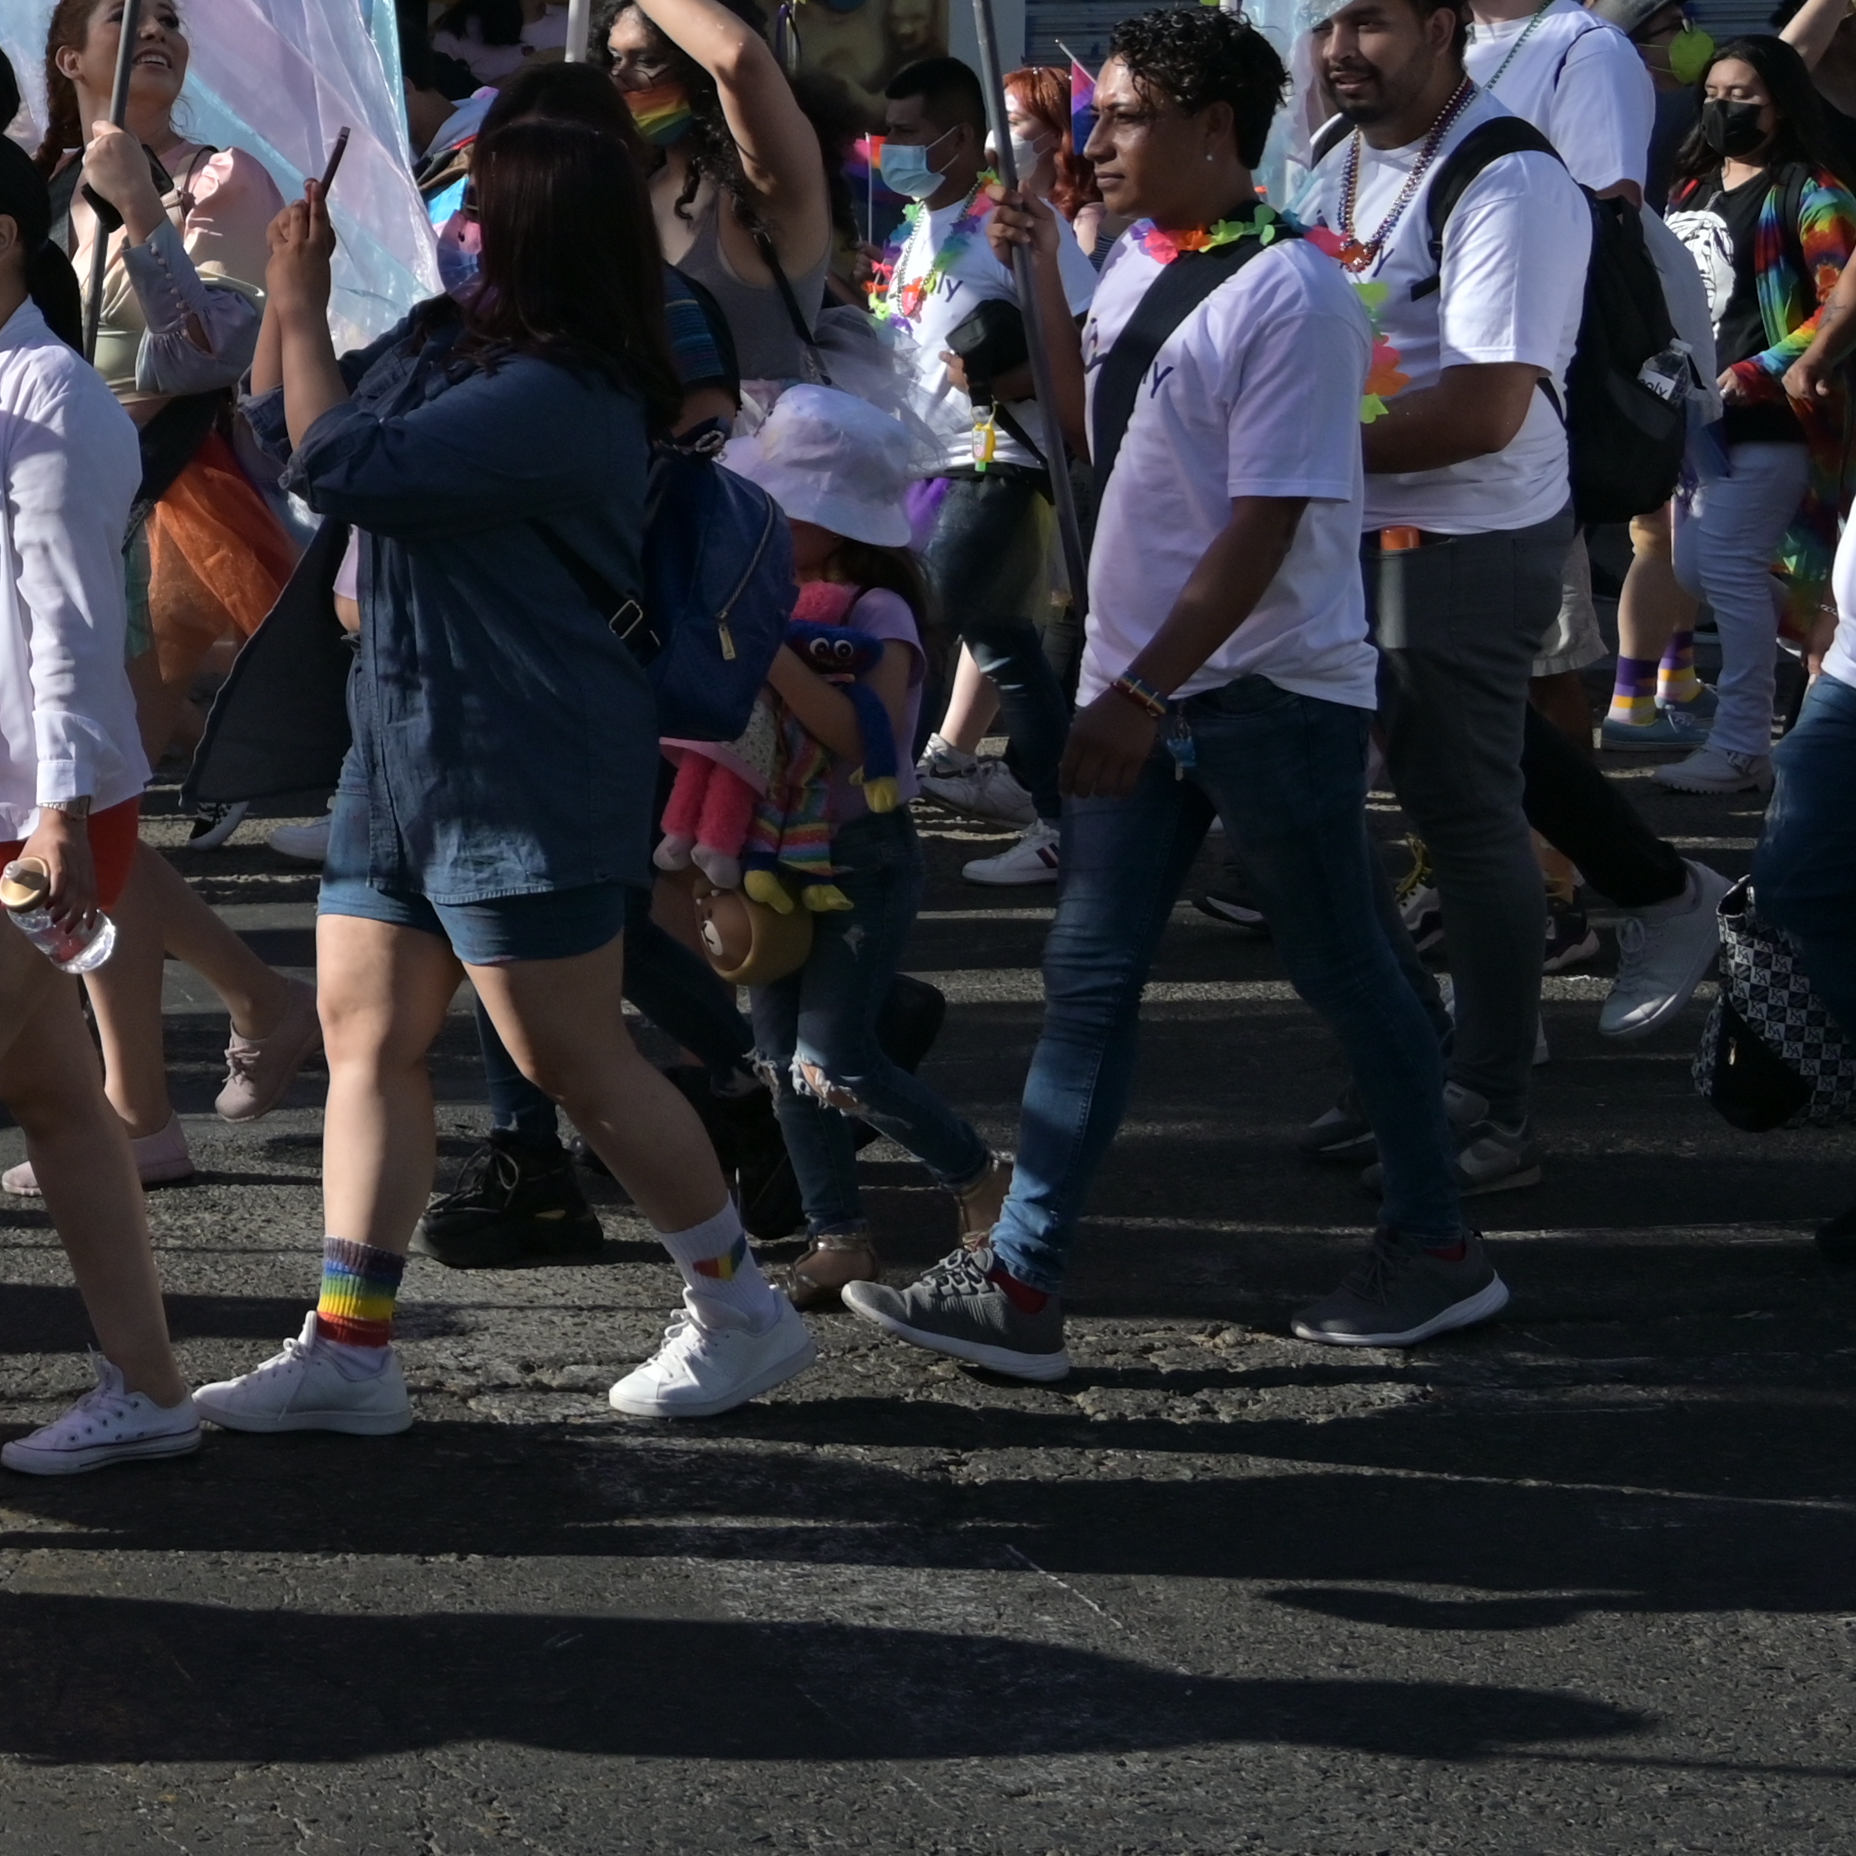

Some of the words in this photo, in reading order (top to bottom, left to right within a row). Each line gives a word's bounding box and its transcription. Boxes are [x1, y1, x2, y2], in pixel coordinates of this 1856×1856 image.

[1737, 946, 1750, 963] KA
[1774, 956, 1789, 972] KA
[1753, 967, 1768, 985] KA
[1793, 975, 1808, 992] KA
[1734, 980, 1747, 998] KA
[1770, 989, 1785, 1005] KA
[1750, 1002, 1765, 1019] KA
[1789, 1009, 1804, 1024] KA
[1767, 1022, 1782, 1039] KA
[1785, 1041, 1800, 1057] KA
[1803, 1060, 1817, 1074] KA
